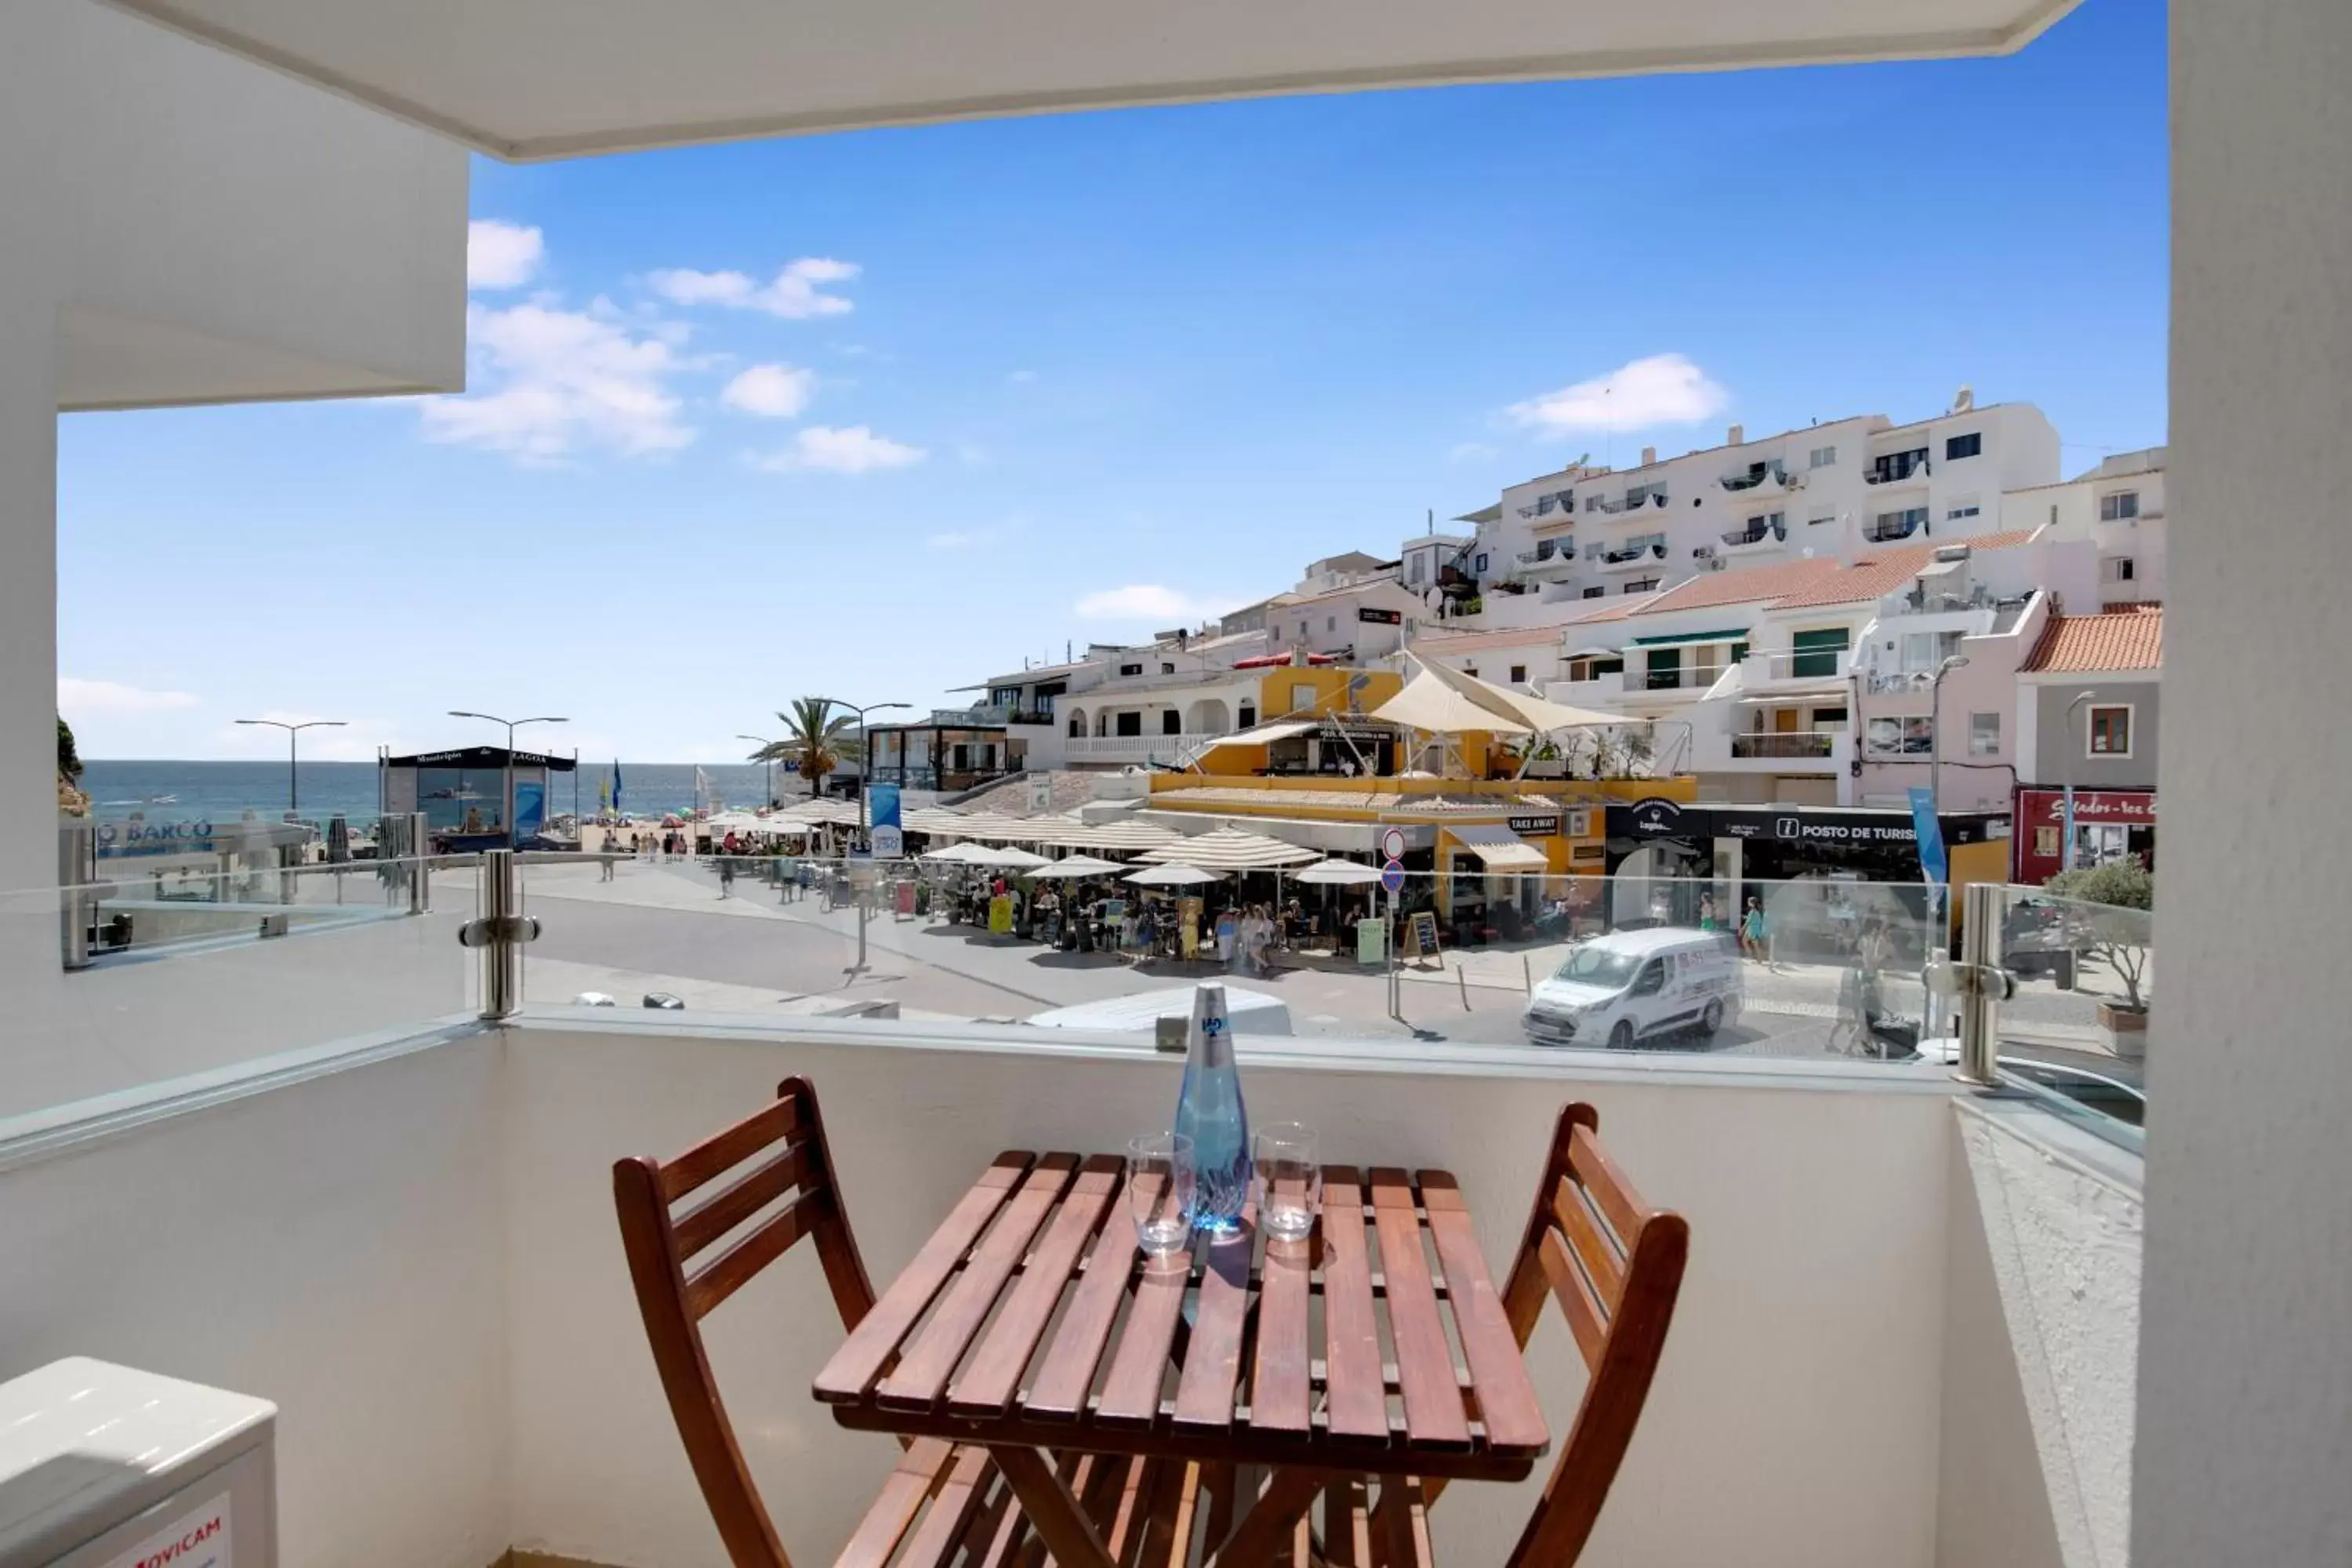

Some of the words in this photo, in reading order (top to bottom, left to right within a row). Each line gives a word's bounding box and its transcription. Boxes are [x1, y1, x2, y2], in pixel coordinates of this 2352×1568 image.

[127, 819, 212, 841] BARCO
[1512, 819, 1531, 829] TAKE
[1533, 818, 1555, 828] AWAY
[1803, 826, 1848, 837] POSTO
[1852, 827, 1871, 838] DE
[1873, 828, 1918, 840] TURIS
